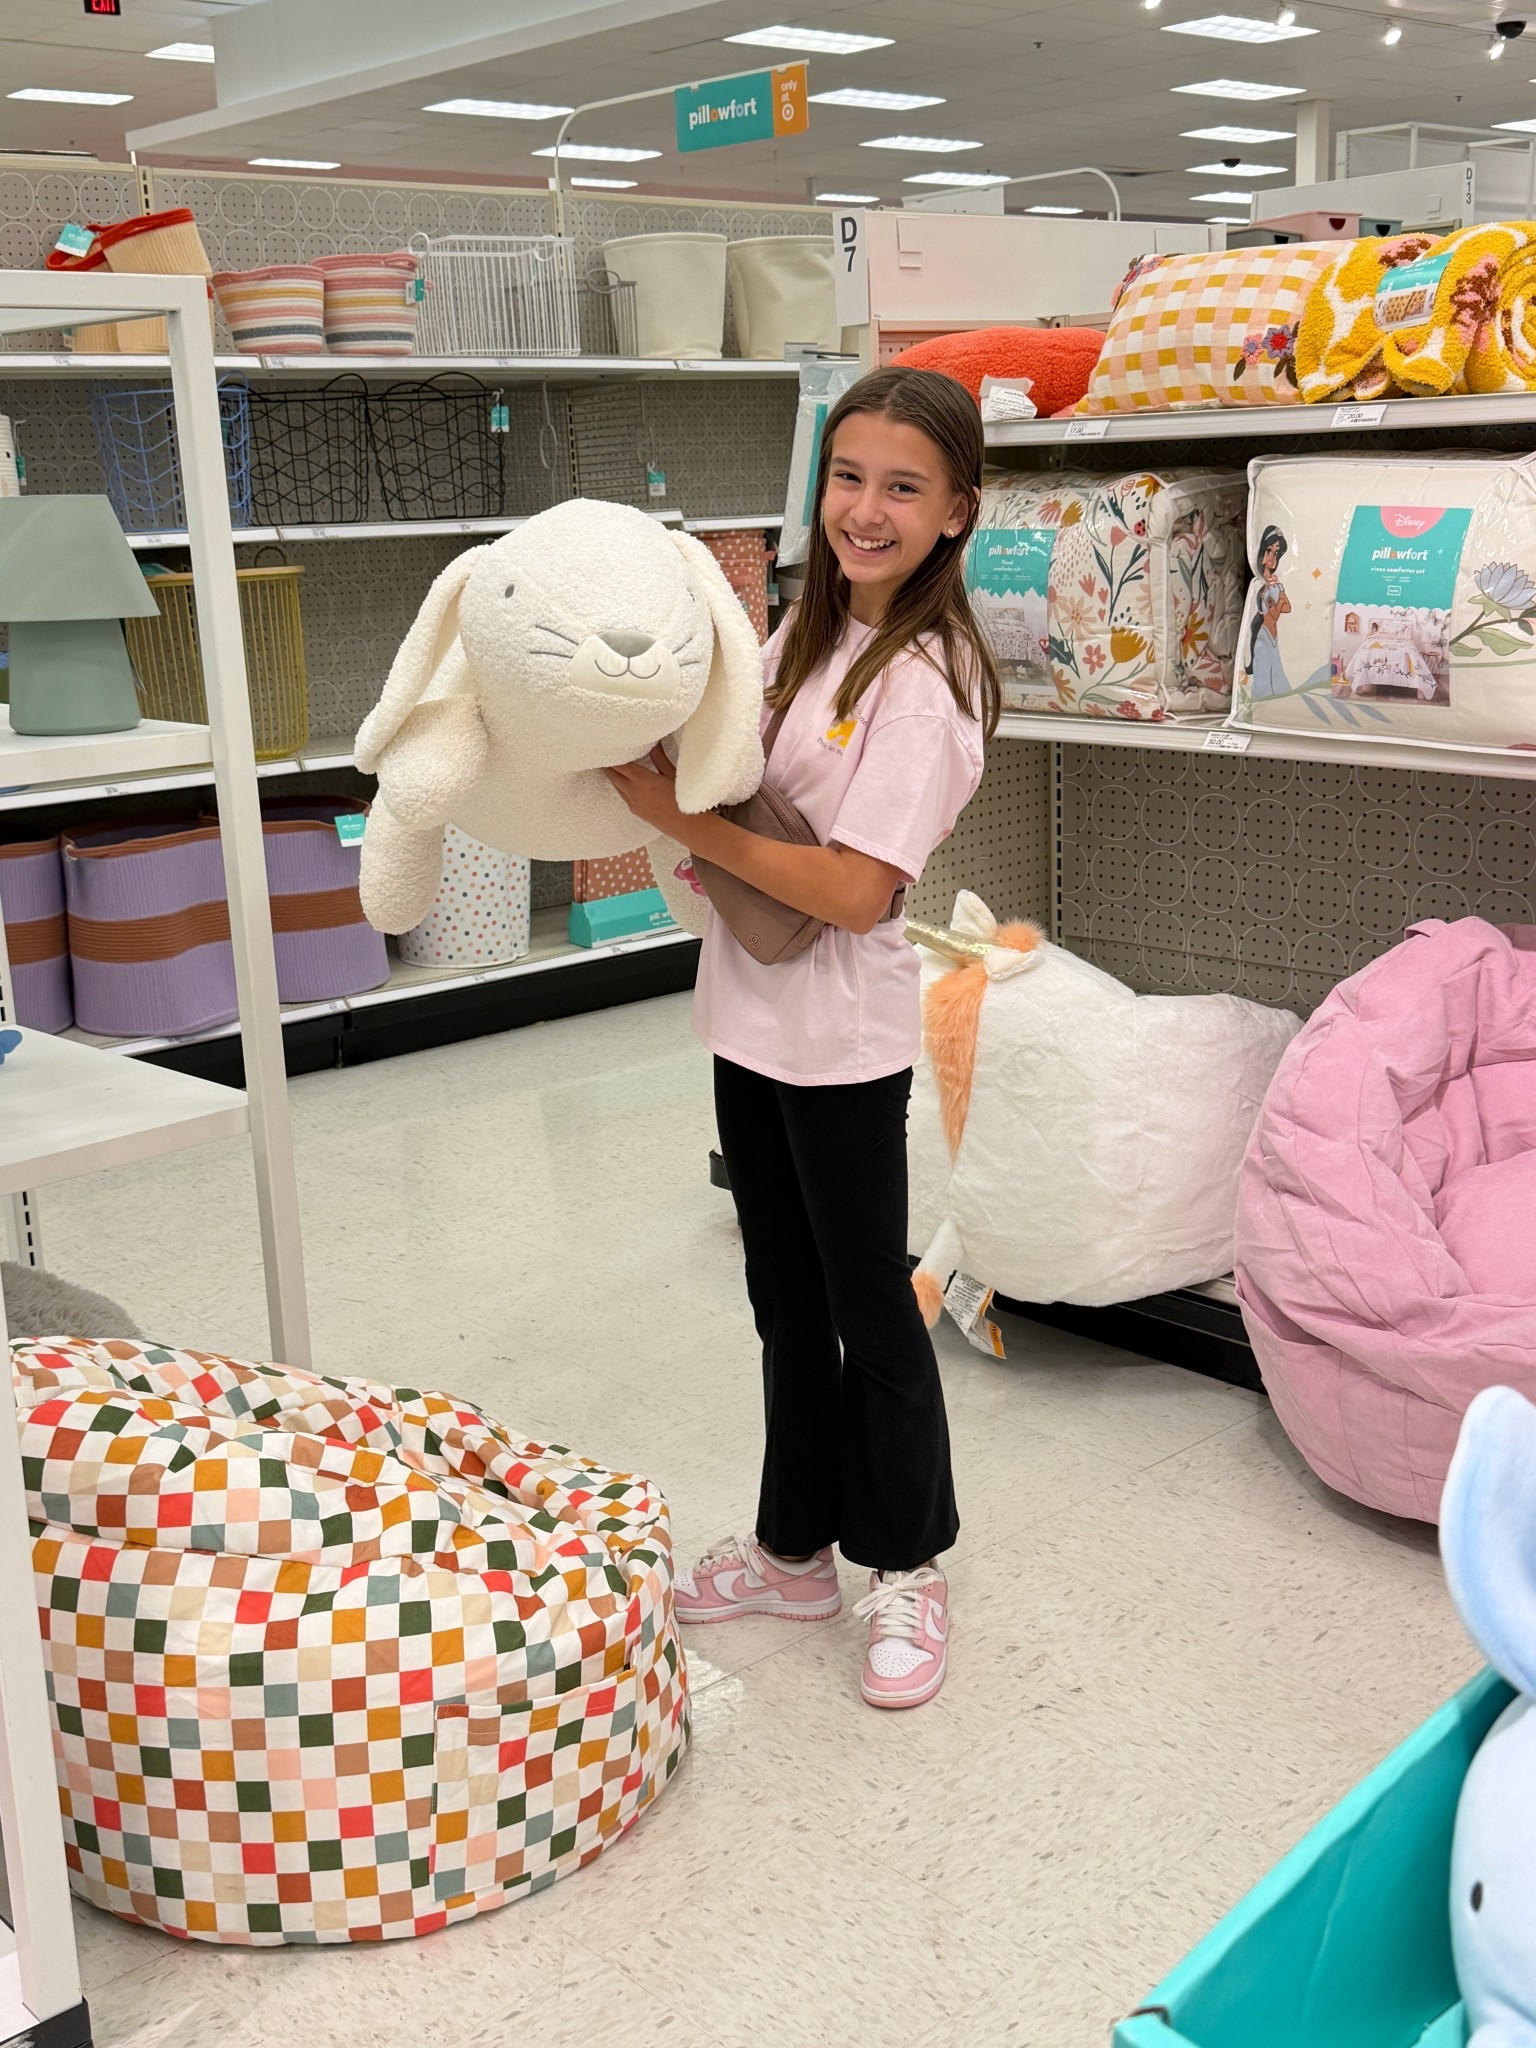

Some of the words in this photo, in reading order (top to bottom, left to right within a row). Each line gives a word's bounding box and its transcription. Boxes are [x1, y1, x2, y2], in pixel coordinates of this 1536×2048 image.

[780, 80, 797, 92] only
[780, 92, 790, 102] at
[688, 97, 758, 130] pillowfort
[1394, 513, 1425, 530] Disney
[988, 545, 1029, 557] pillowfort
[1371, 547, 1428, 560] pillowfort
